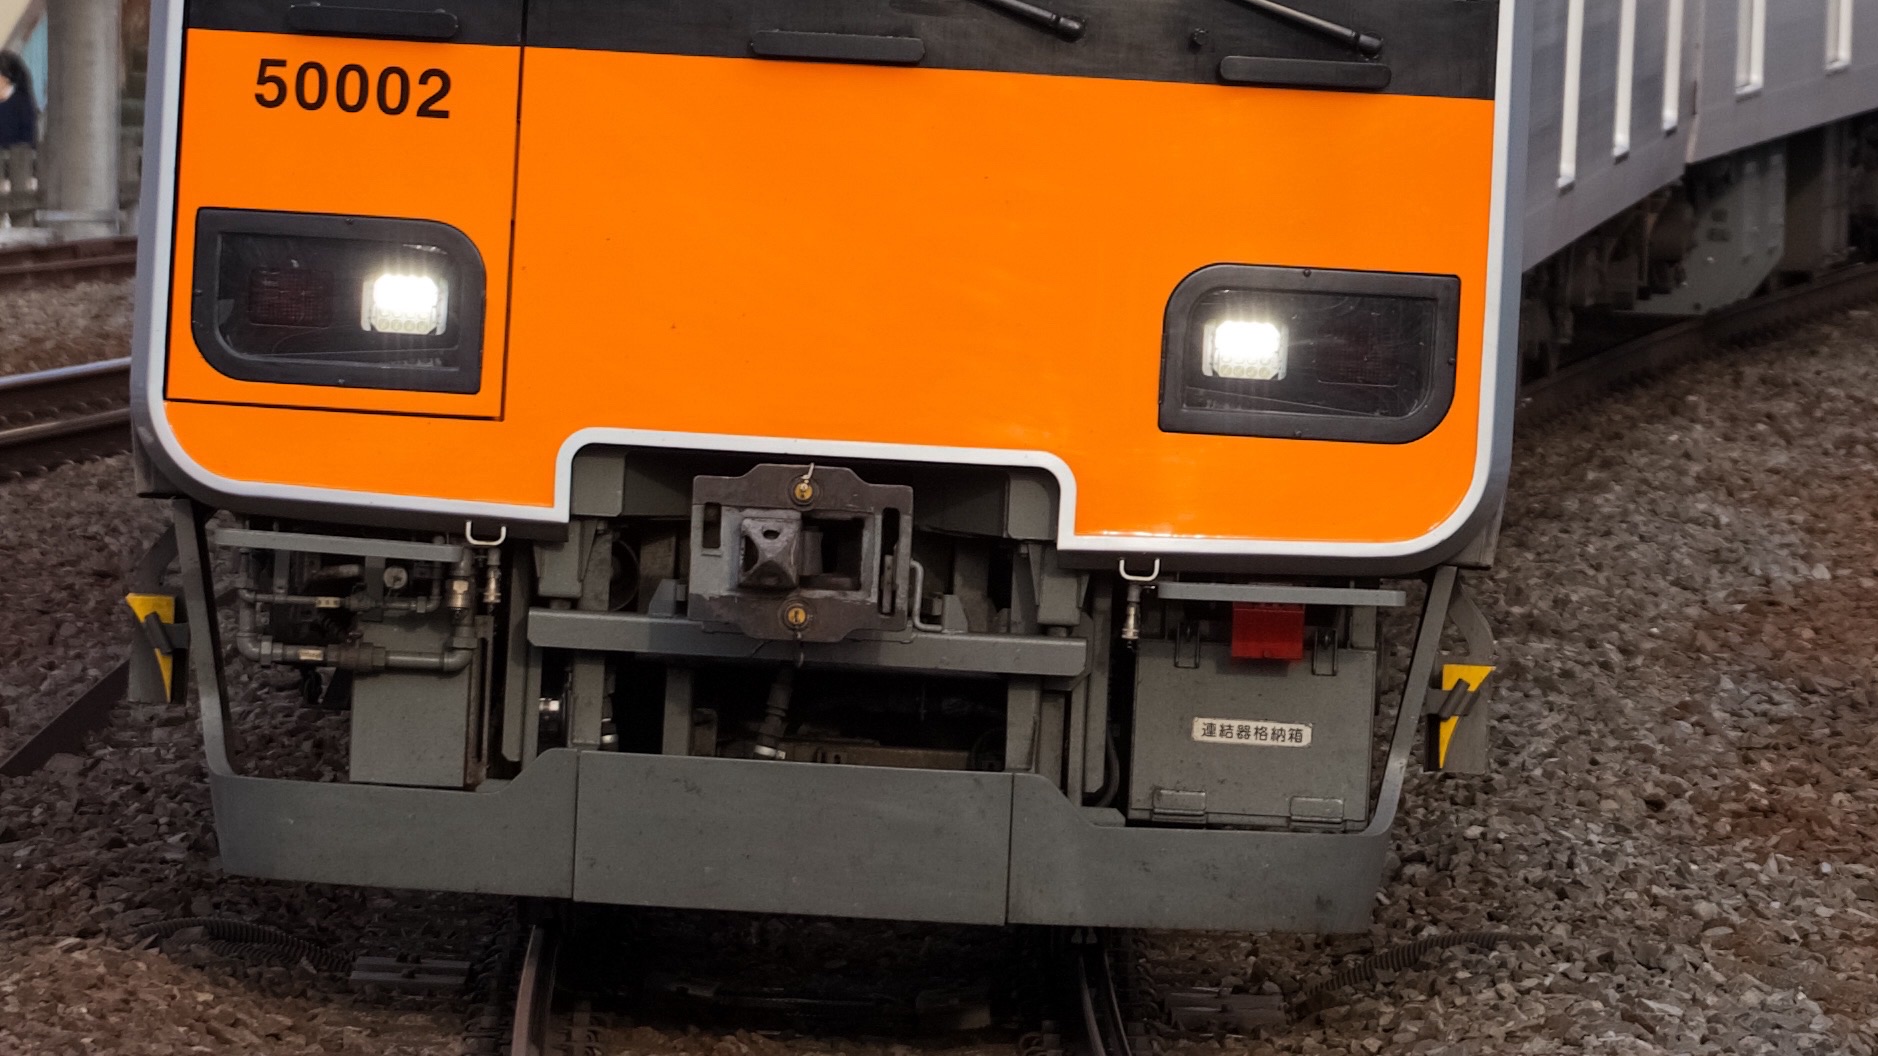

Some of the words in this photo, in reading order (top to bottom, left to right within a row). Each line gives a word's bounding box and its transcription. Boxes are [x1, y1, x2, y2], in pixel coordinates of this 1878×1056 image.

[254, 58, 452, 119] 50002
[1201, 721, 1304, 743] 連結器格納箱
